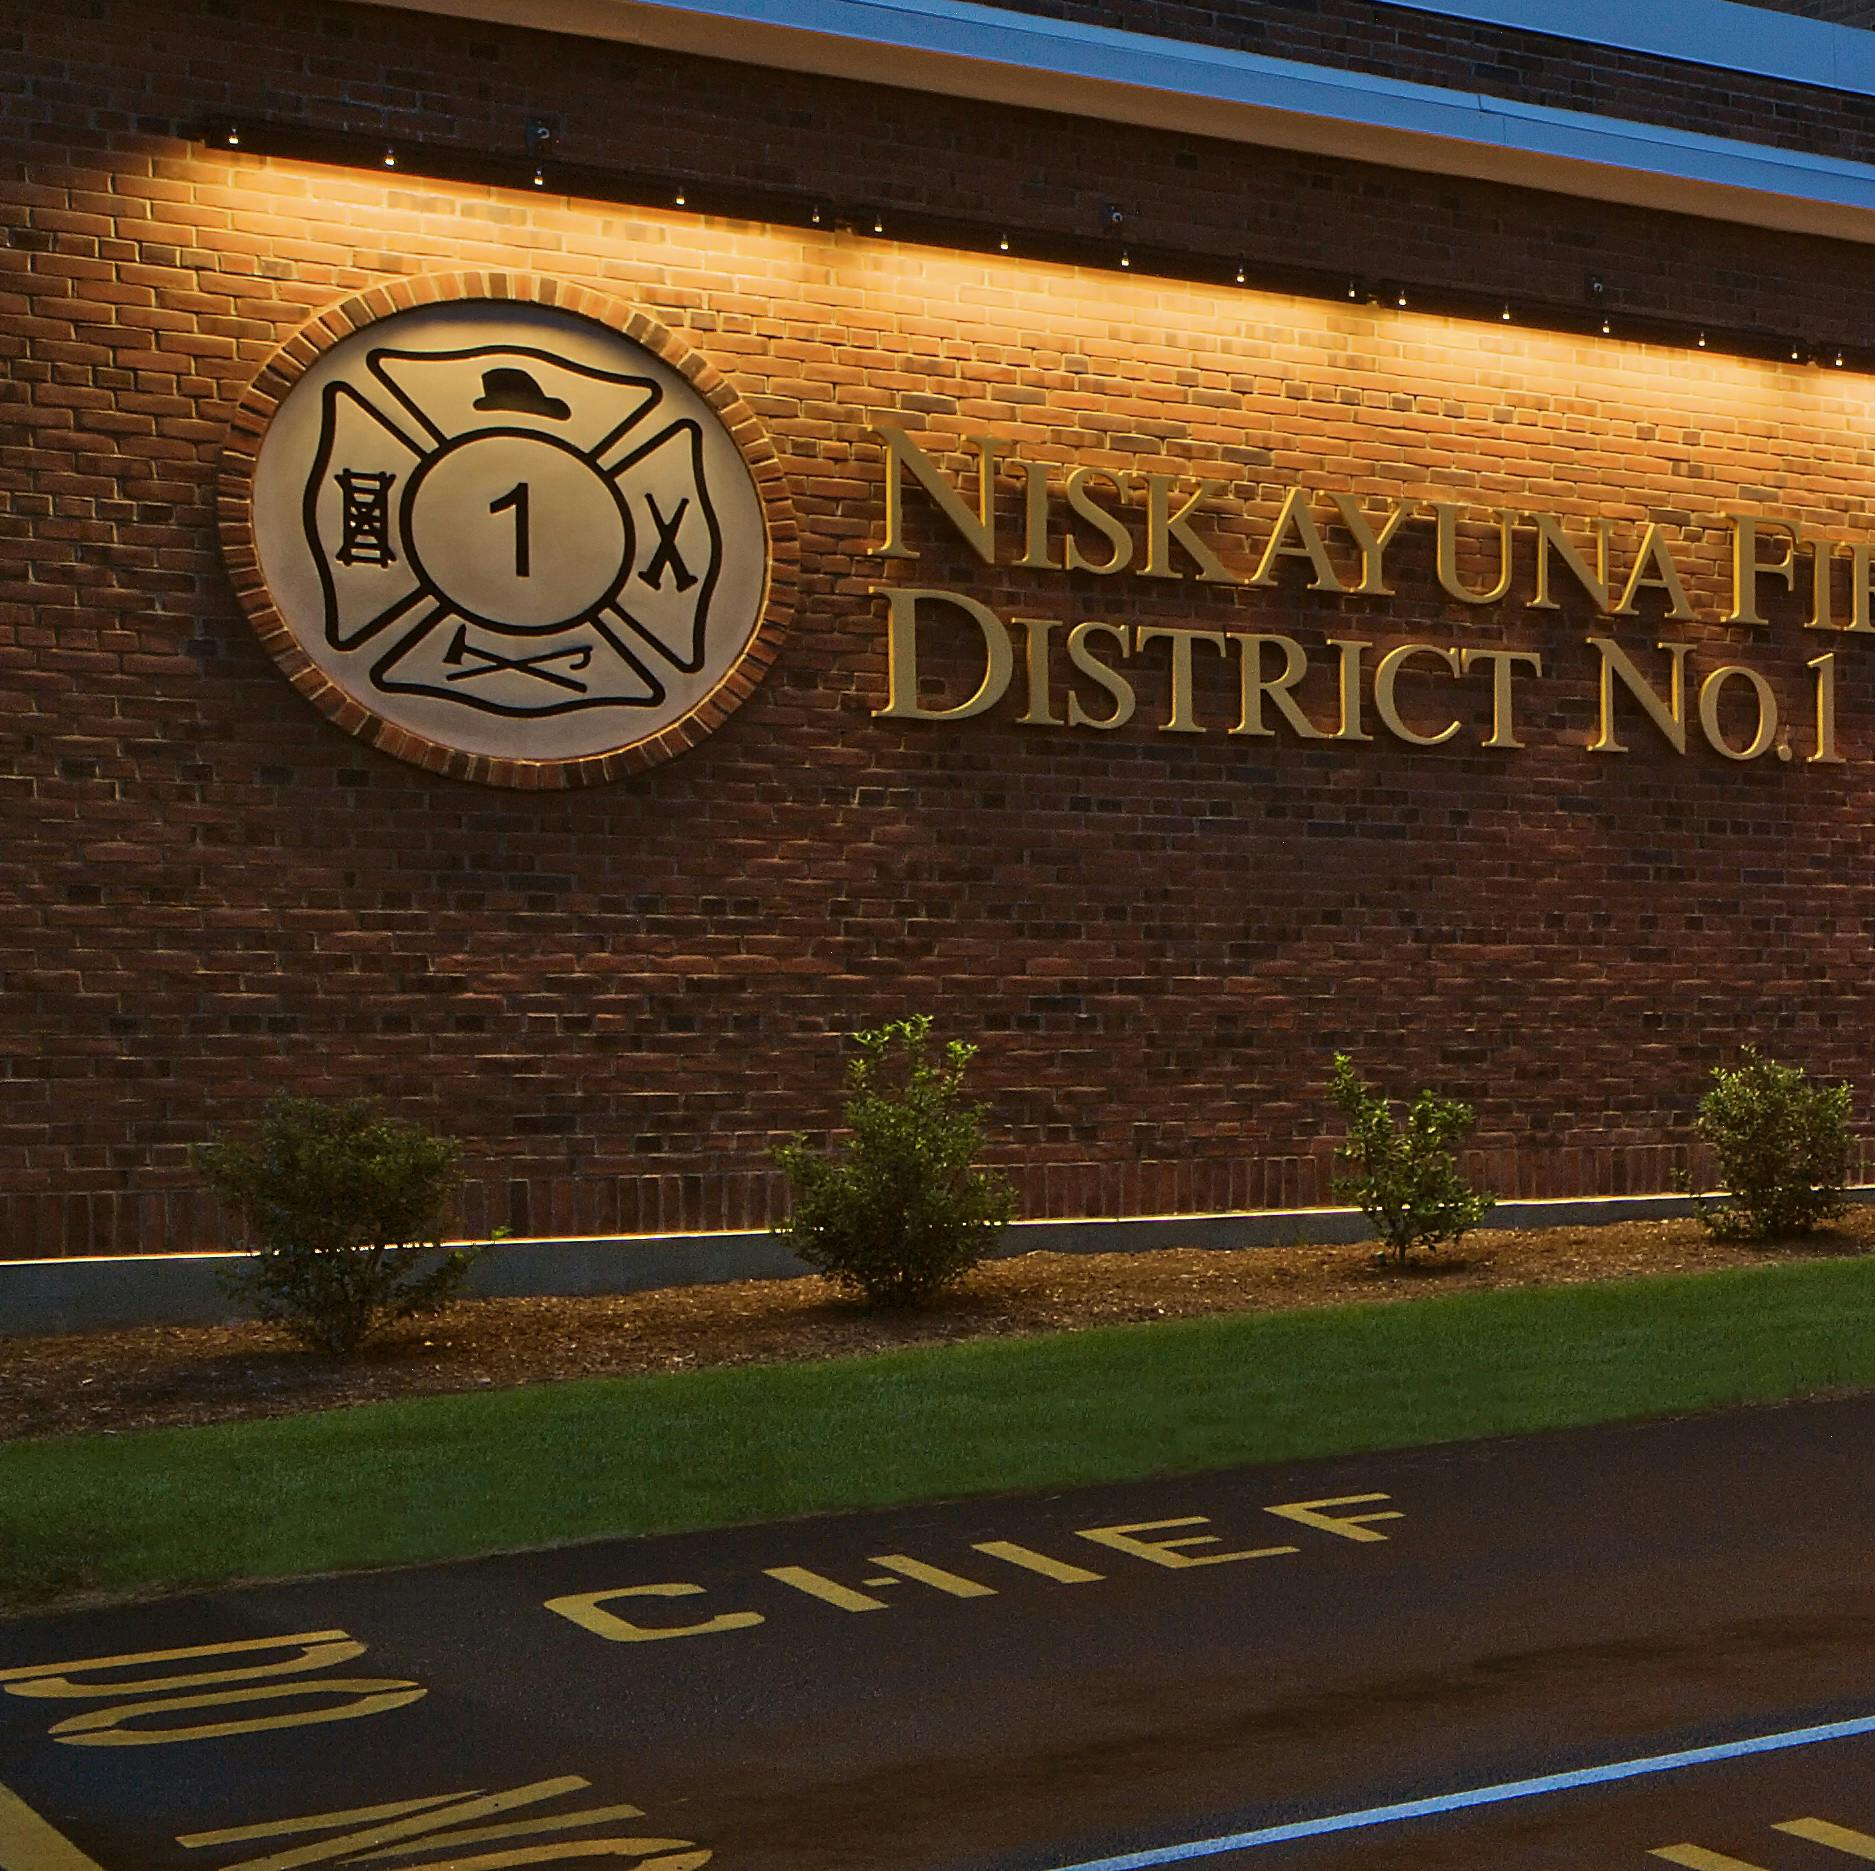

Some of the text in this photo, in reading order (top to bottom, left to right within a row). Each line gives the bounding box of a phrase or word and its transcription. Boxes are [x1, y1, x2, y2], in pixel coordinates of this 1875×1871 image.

[488, 481, 531, 580] 1
[863, 424, 1702, 622] NISKAYUNA
[868, 585, 1542, 749] DISTRICT
[543, 1491, 1407, 1643] CHIEF
